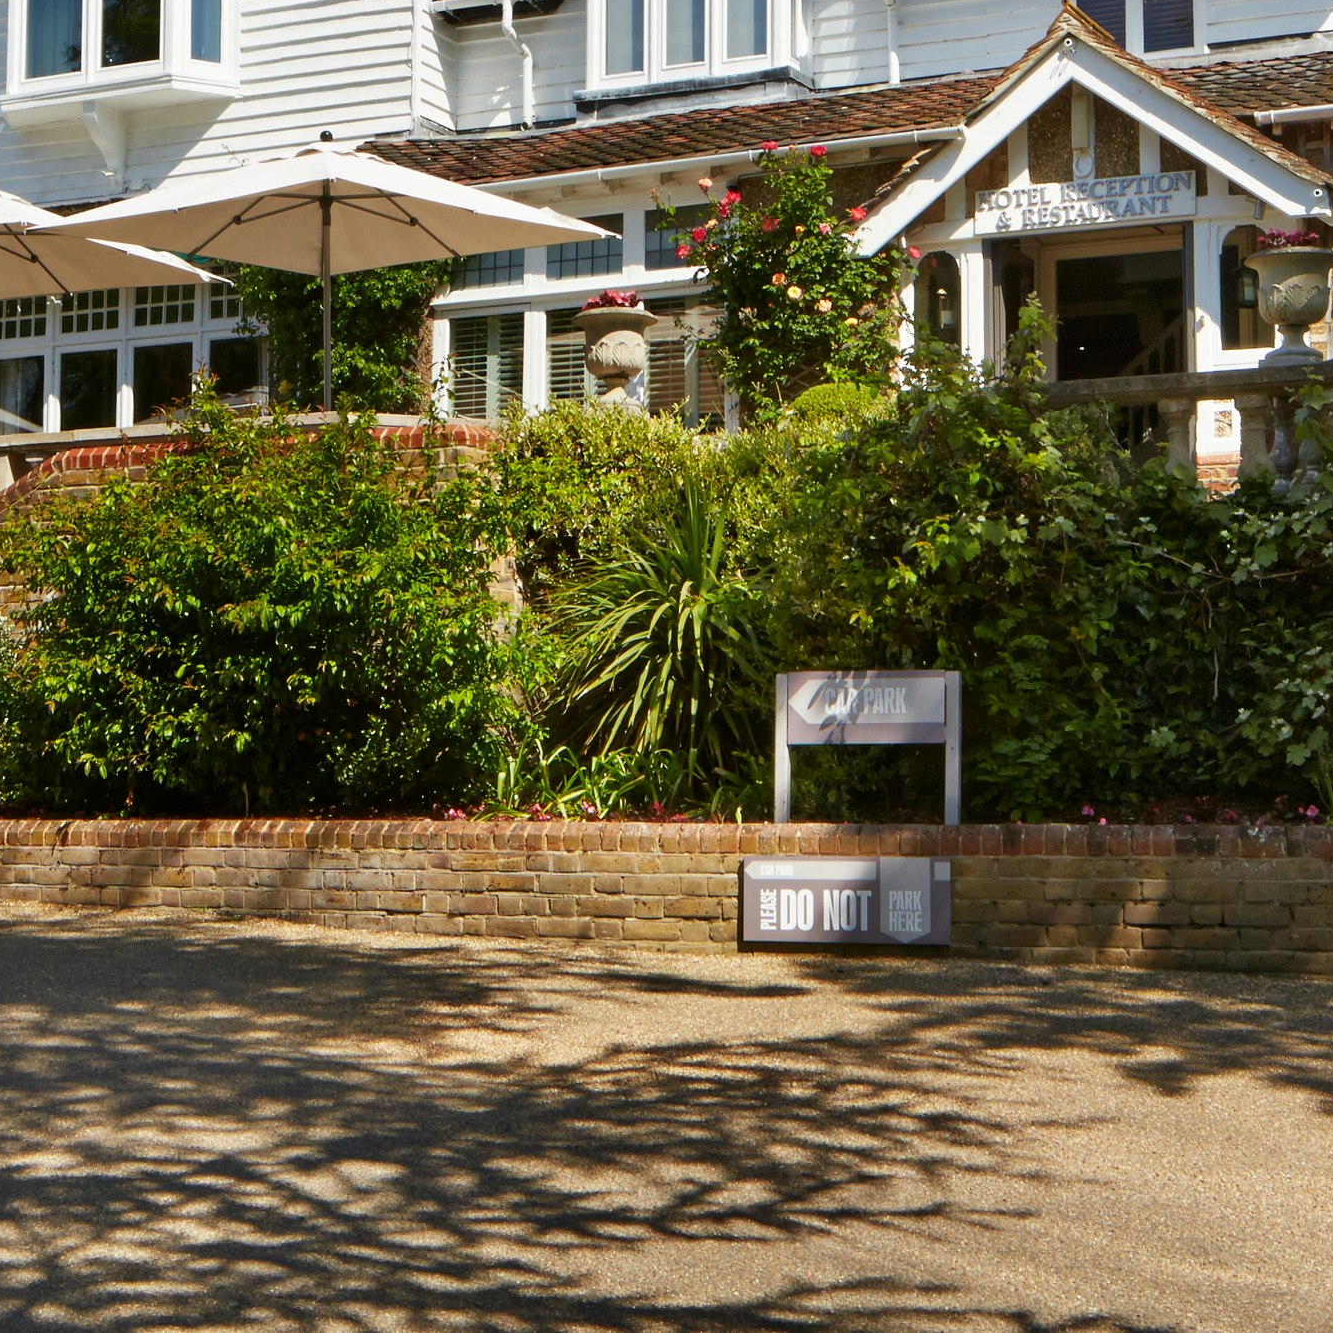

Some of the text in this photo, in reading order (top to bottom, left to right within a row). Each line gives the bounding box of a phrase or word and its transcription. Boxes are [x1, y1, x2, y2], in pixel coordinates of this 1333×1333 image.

[977, 171, 1193, 212] HOTEL RECEPTION
[995, 195, 1172, 232] & RESTAURANT
[824, 687, 907, 715] CAR PARK
[760, 864, 794, 876] CAR PARK
[760, 889, 777, 930] PLEASE
[780, 888, 872, 932] DO NOT
[889, 891, 922, 910] PARK
[889, 911, 922, 932] HERE
